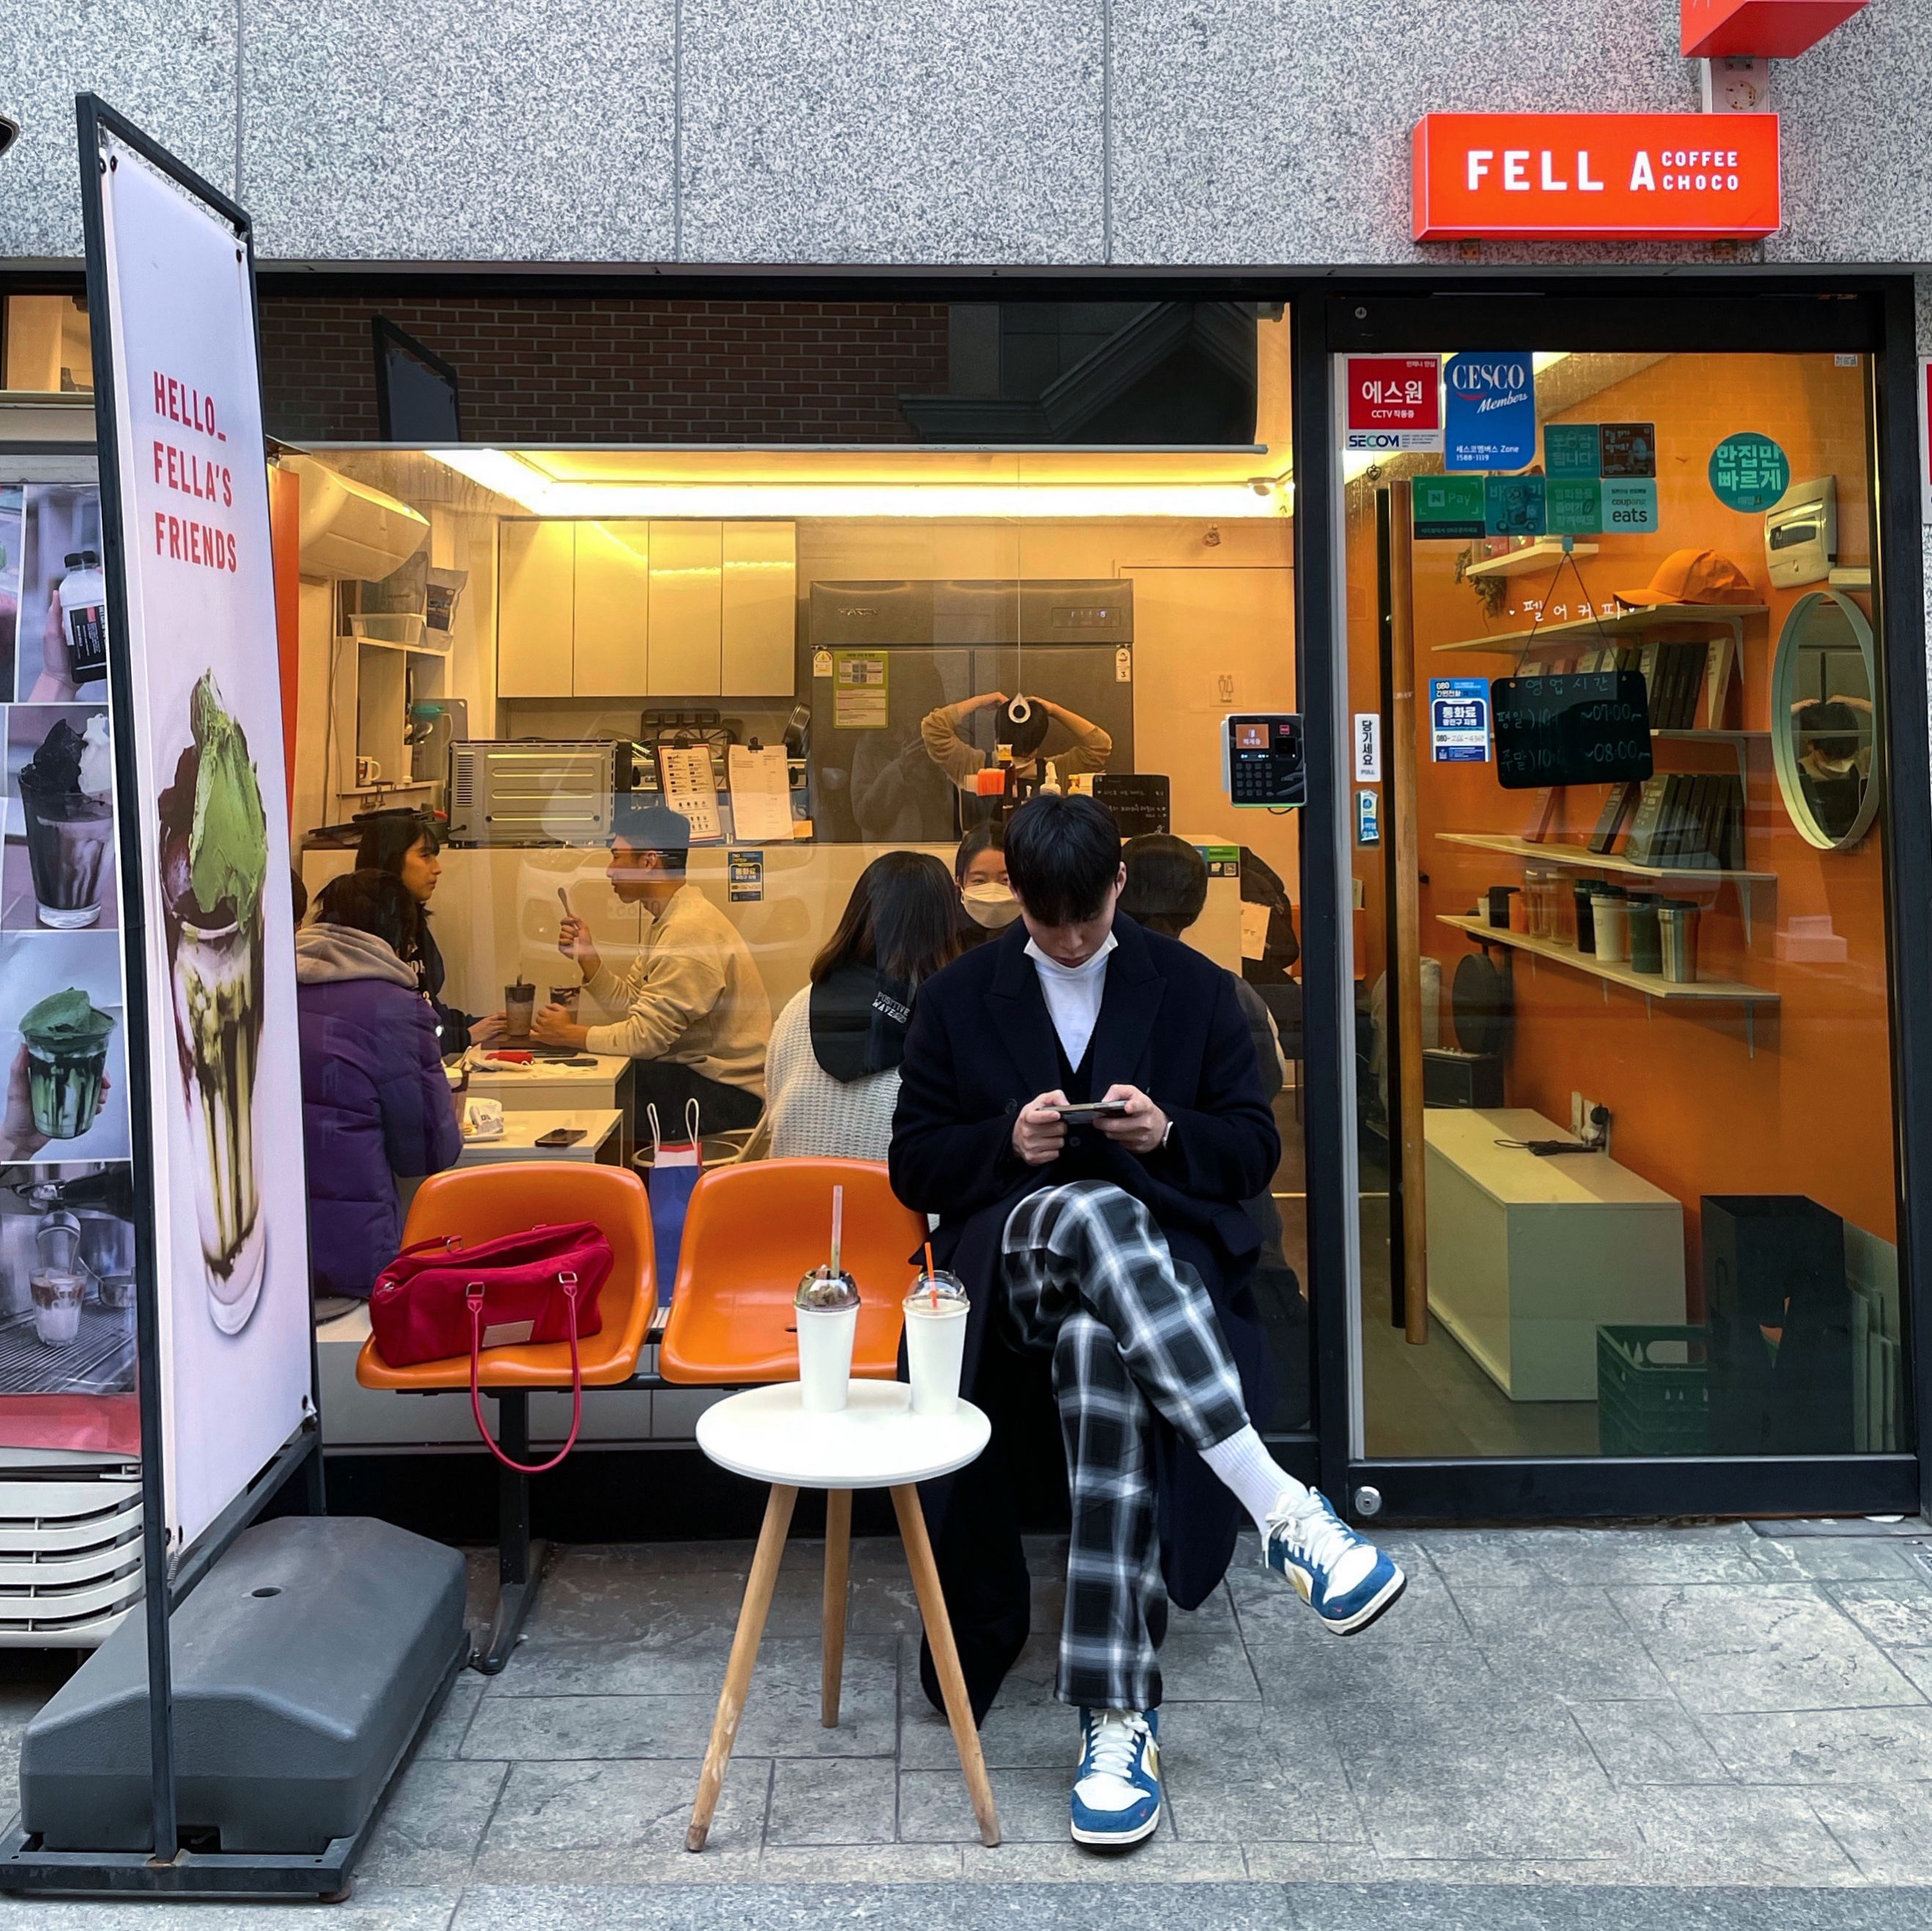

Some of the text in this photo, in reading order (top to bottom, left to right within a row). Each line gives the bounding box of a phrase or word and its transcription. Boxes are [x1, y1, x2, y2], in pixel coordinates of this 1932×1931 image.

[1662, 152, 1738, 167] COFFEE
[1662, 174, 1739, 191] CHOCO
[1452, 364, 1524, 389] CESCO
[1362, 380, 1423, 404] 에스원
[1477, 391, 1529, 414] Members
[1371, 410, 1415, 419] CCTV 작동중
[1349, 435, 1399, 448] SECOM
[1456, 445, 1519, 454] 세스코멤버스 Zone
[1716, 444, 1781, 468] 한집만
[153, 441, 232, 507] FELLA'S
[1717, 469, 1781, 491] 빠르게
[1448, 492, 1471, 506] Pay
[1612, 508, 1647, 523] eats
[154, 512, 237, 573] FRIENDS
[1442, 706, 1476, 718] 통화료
[1362, 720, 1373, 765] 당기세요
[877, 991, 910, 1017] POSITIVE
